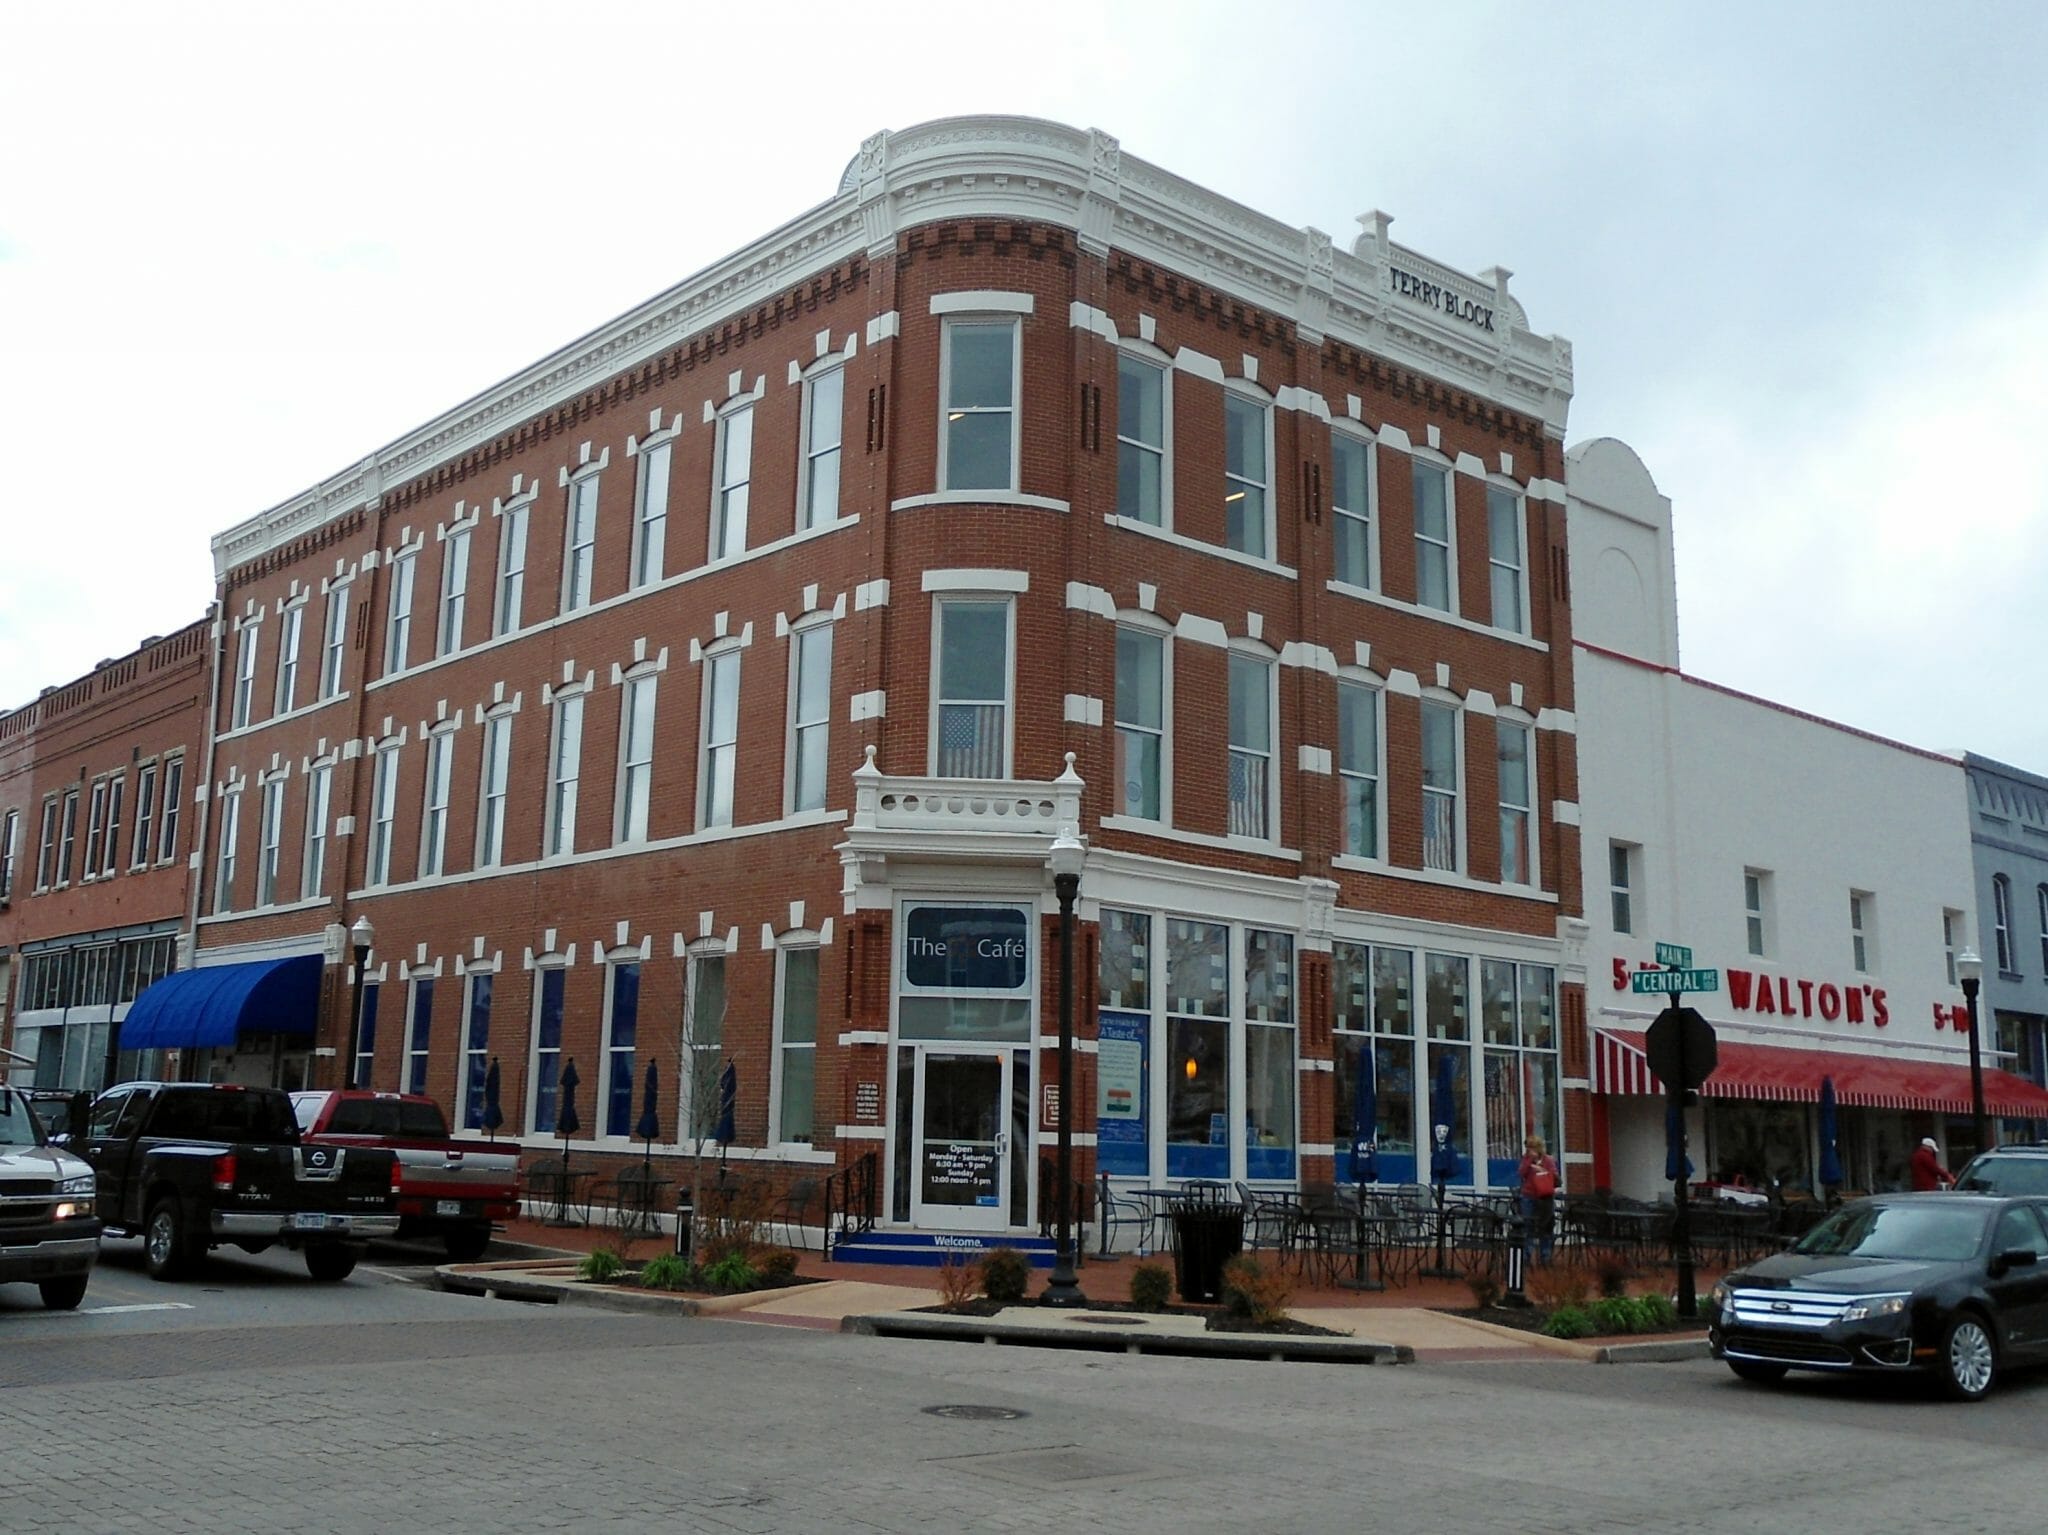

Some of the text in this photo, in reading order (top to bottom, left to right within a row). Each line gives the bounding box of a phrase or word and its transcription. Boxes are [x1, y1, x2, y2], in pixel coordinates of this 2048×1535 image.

[1390, 266, 1494, 332] TERRY BLOCK
[908, 936, 1024, 958] The Café
[1661, 945, 1683, 966] MAIN
[1642, 972, 1700, 991] CENTRAL
[1727, 969, 1889, 1028] WALTON'S
[950, 1144, 973, 1153] Open
[929, 1153, 957, 1162] Monday
[962, 1154, 994, 1163] Saturday
[947, 1169, 974, 1178] Sunday
[979, 1178, 992, 1186] pm
[934, 1235, 983, 1248] Welcome.
